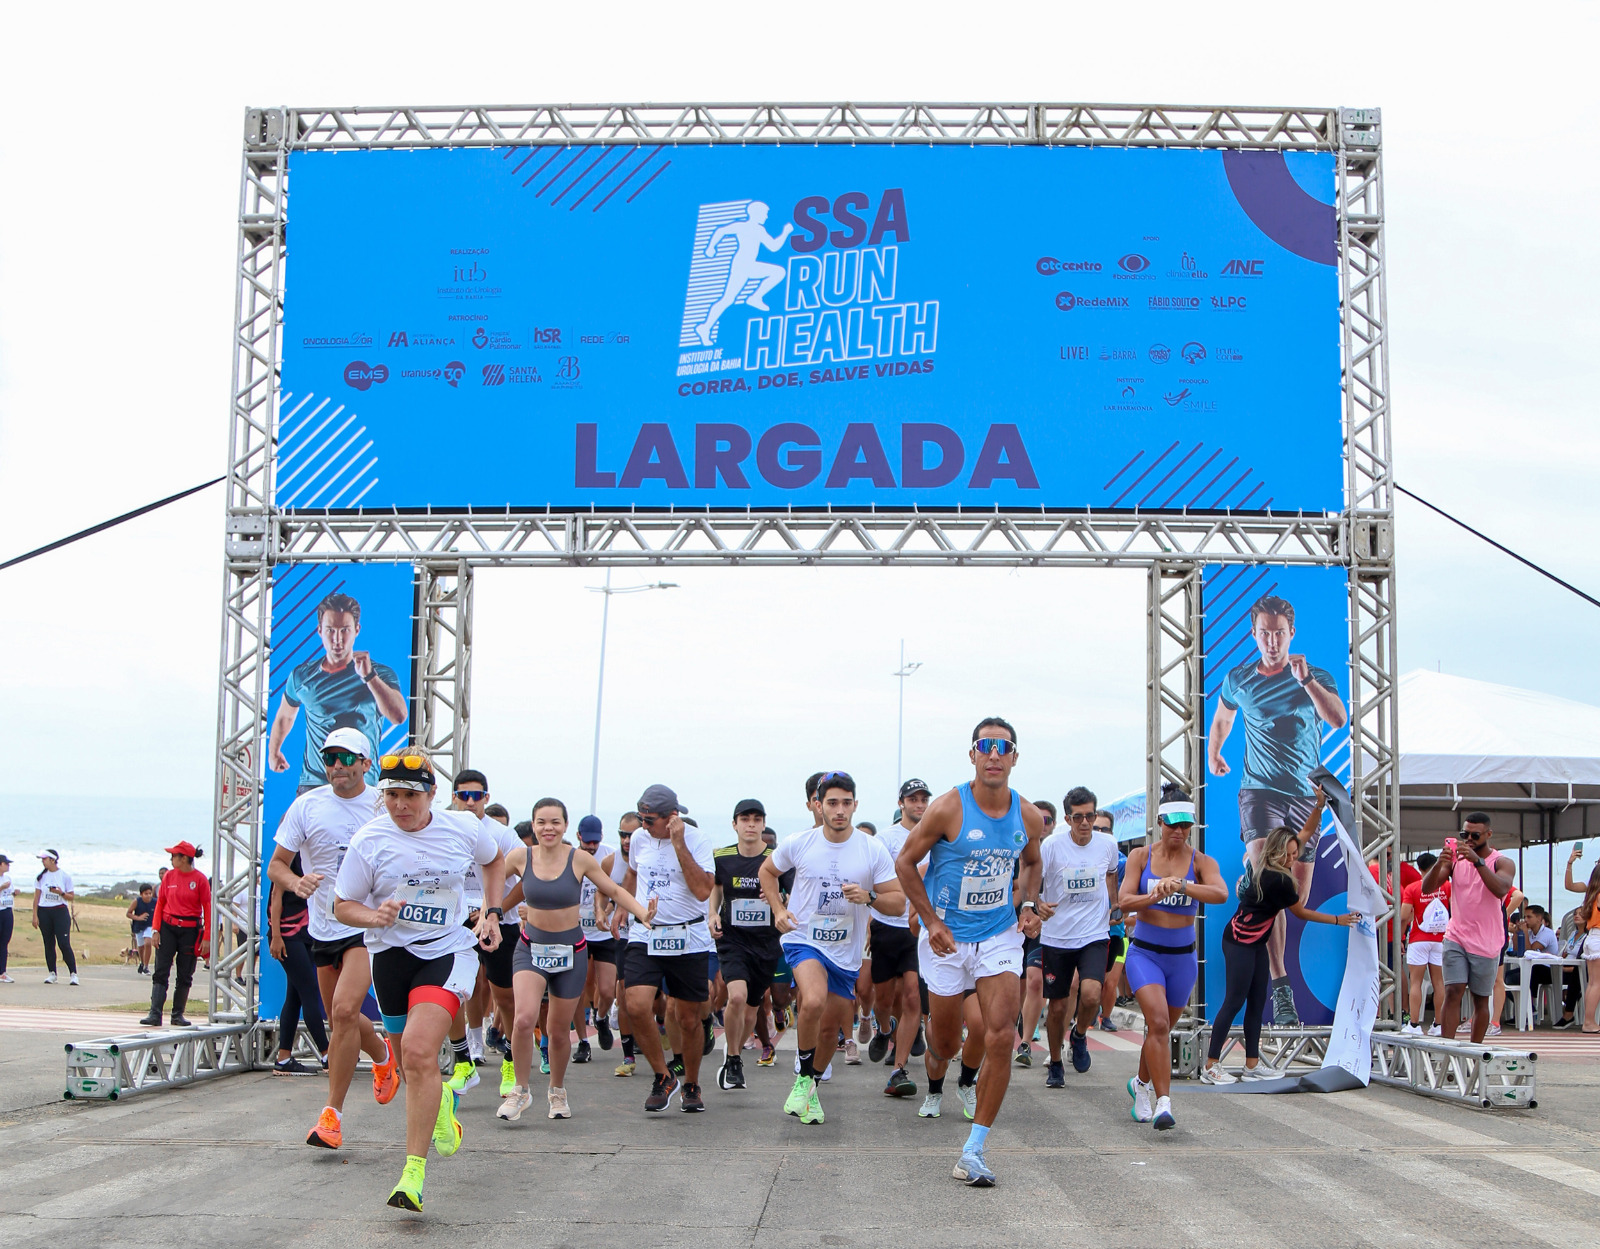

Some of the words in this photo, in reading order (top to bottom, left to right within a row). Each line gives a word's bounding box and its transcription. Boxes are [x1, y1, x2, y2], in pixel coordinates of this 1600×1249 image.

[790, 188, 910, 253] SSA
[450, 248, 490, 256] REALIZAÇÃO
[785, 245, 898, 311] RUN
[1191, 270, 1208, 279] ello
[1148, 296, 1170, 307] FÁBIO
[1172, 296, 1200, 307] SOUTO
[303, 337, 349, 345] ONCOLOGIA
[580, 336, 604, 344] REDE
[744, 301, 939, 371] HEALTH
[412, 338, 456, 346] ALIANÇA
[679, 350, 713, 365] INSTITUTO
[713, 348, 724, 360] DE
[1060, 346, 1089, 360] LIVE!
[1112, 350, 1137, 360] BARRA
[509, 366, 538, 375] SANTA
[677, 362, 709, 377] UROLOGIA
[710, 361, 720, 373] DA
[721, 358, 742, 371] BAHIA
[348, 369, 384, 380] EMS
[509, 375, 543, 383] HELENA
[678, 377, 752, 397] CORRA,
[758, 372, 803, 390] DOE,
[809, 365, 870, 384] SALVE
[875, 359, 935, 378] VIDAS
[1183, 400, 1217, 410] SMILE
[575, 422, 1041, 490] LARGADA
[1070, 879, 1093, 889] 0136
[831, 891, 844, 899] SSA
[970, 890, 1002, 904] 0402
[403, 905, 443, 923] 0614
[738, 911, 763, 921] 0572
[815, 929, 845, 940] 0397
[655, 939, 682, 950] 0481
[539, 957, 564, 968] 0201
